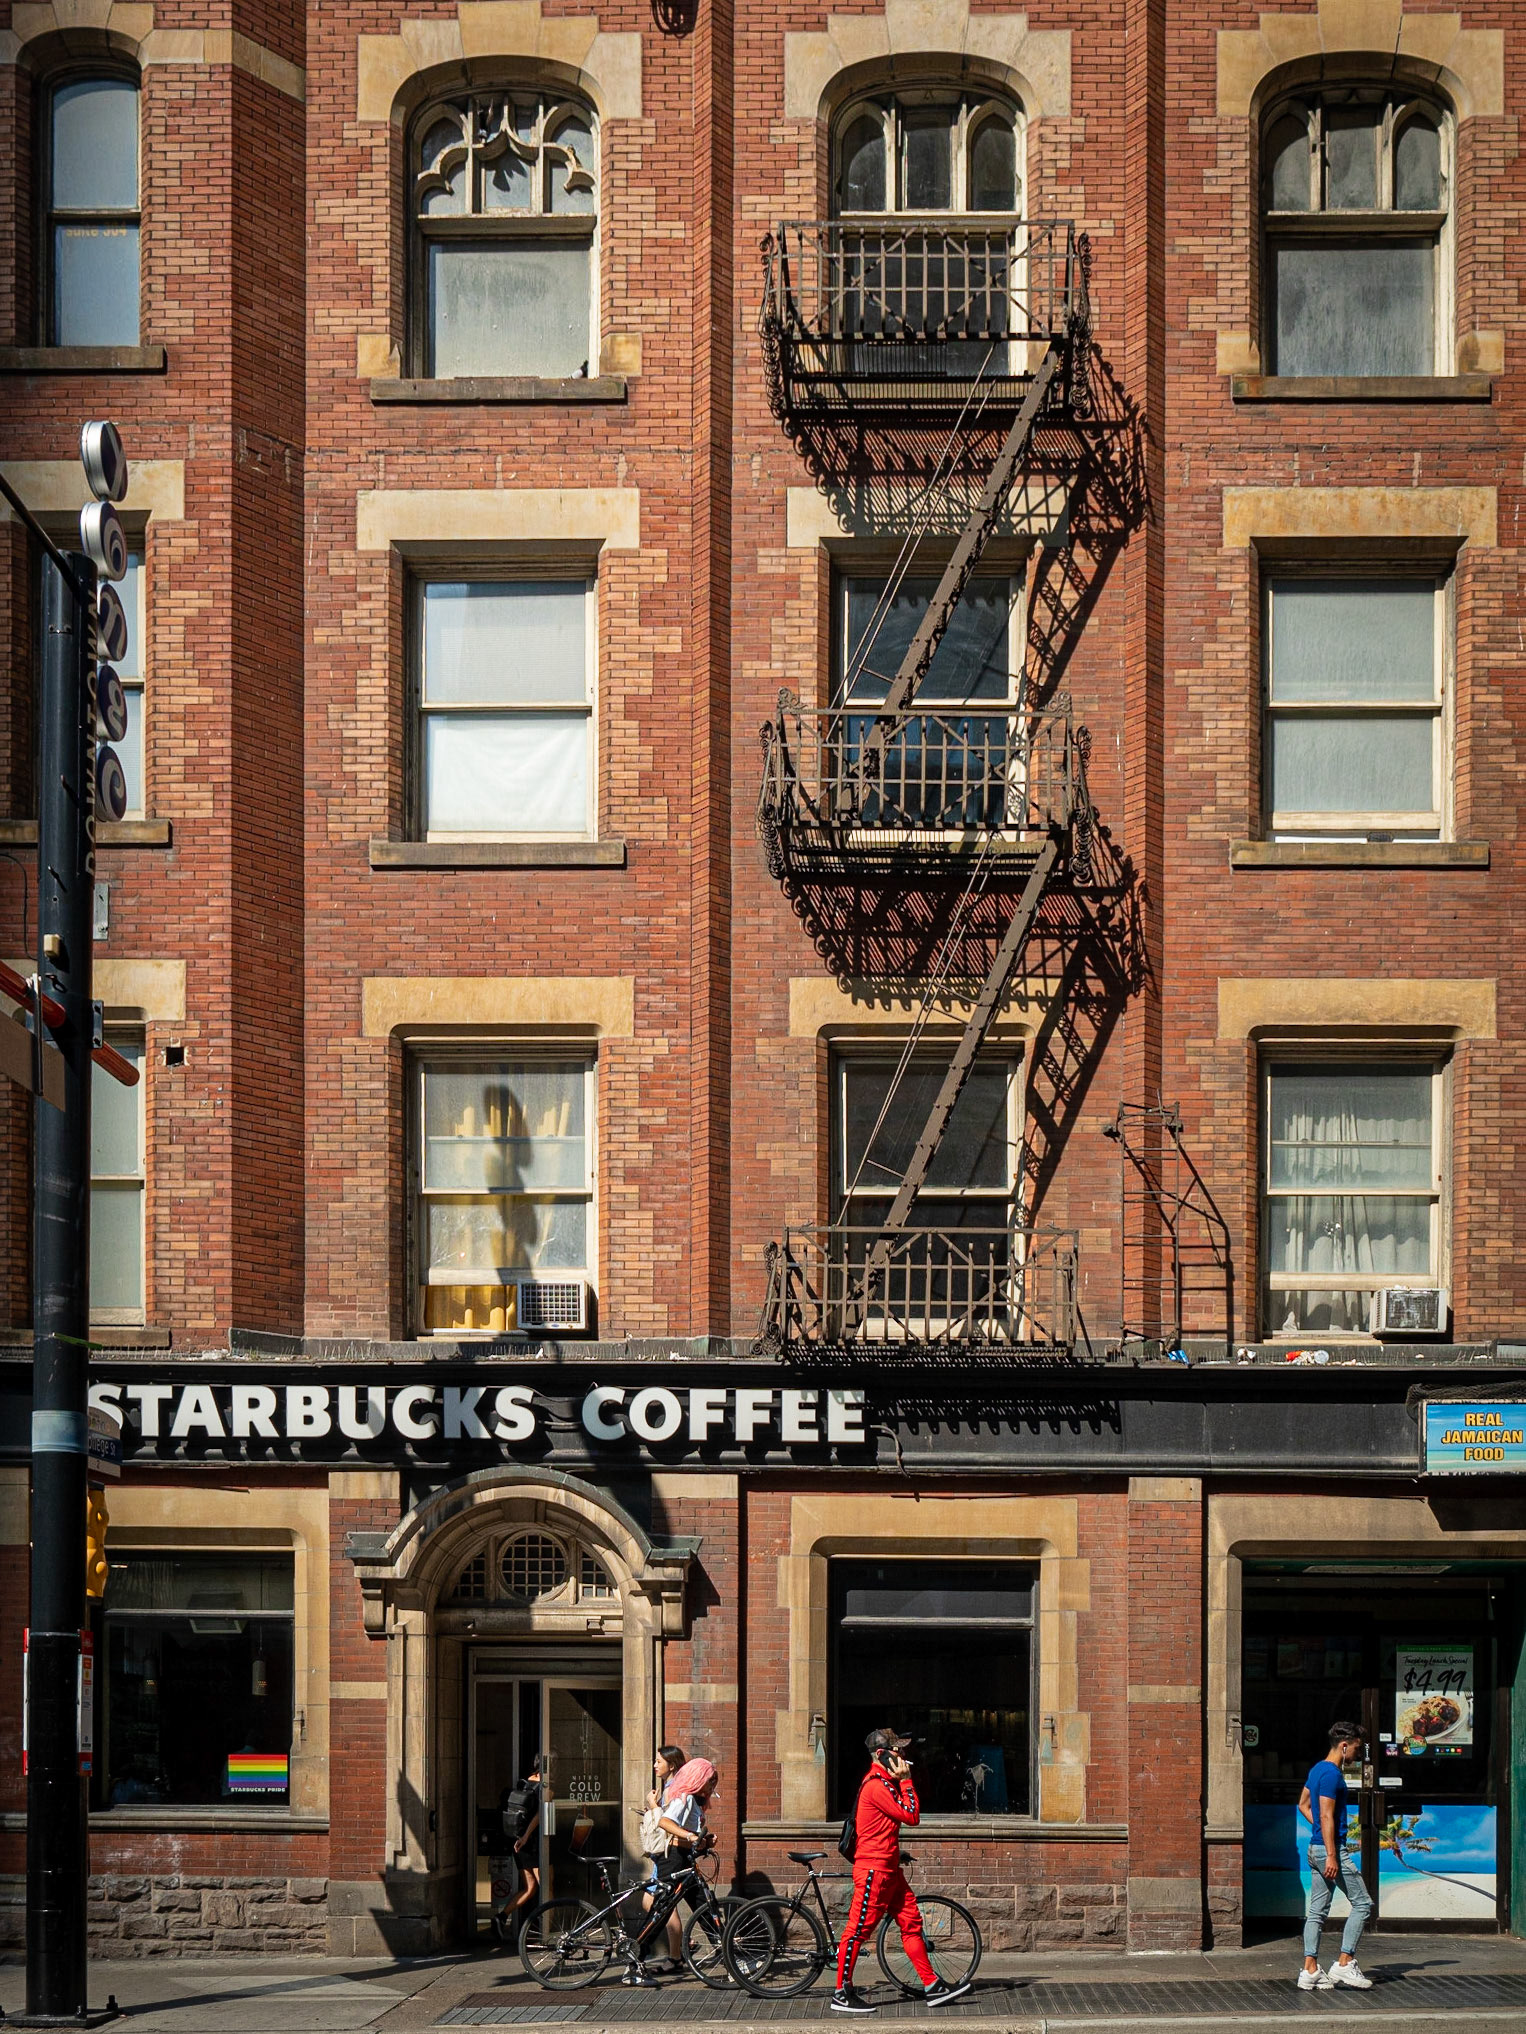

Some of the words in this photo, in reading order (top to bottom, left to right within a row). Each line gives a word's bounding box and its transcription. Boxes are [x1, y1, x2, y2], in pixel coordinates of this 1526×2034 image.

[88, 1384, 536, 1441] STARBUCKS
[582, 1387, 865, 1442] COFFEE
[1465, 1412, 1504, 1427] REAL
[1441, 1430, 1524, 1445] JAMAICAN
[1464, 1447, 1504, 1461] FOOD
[1404, 1667, 1467, 1696] $4.99
[569, 1781, 601, 1791] COLD
[569, 1792, 601, 1802] BREW
